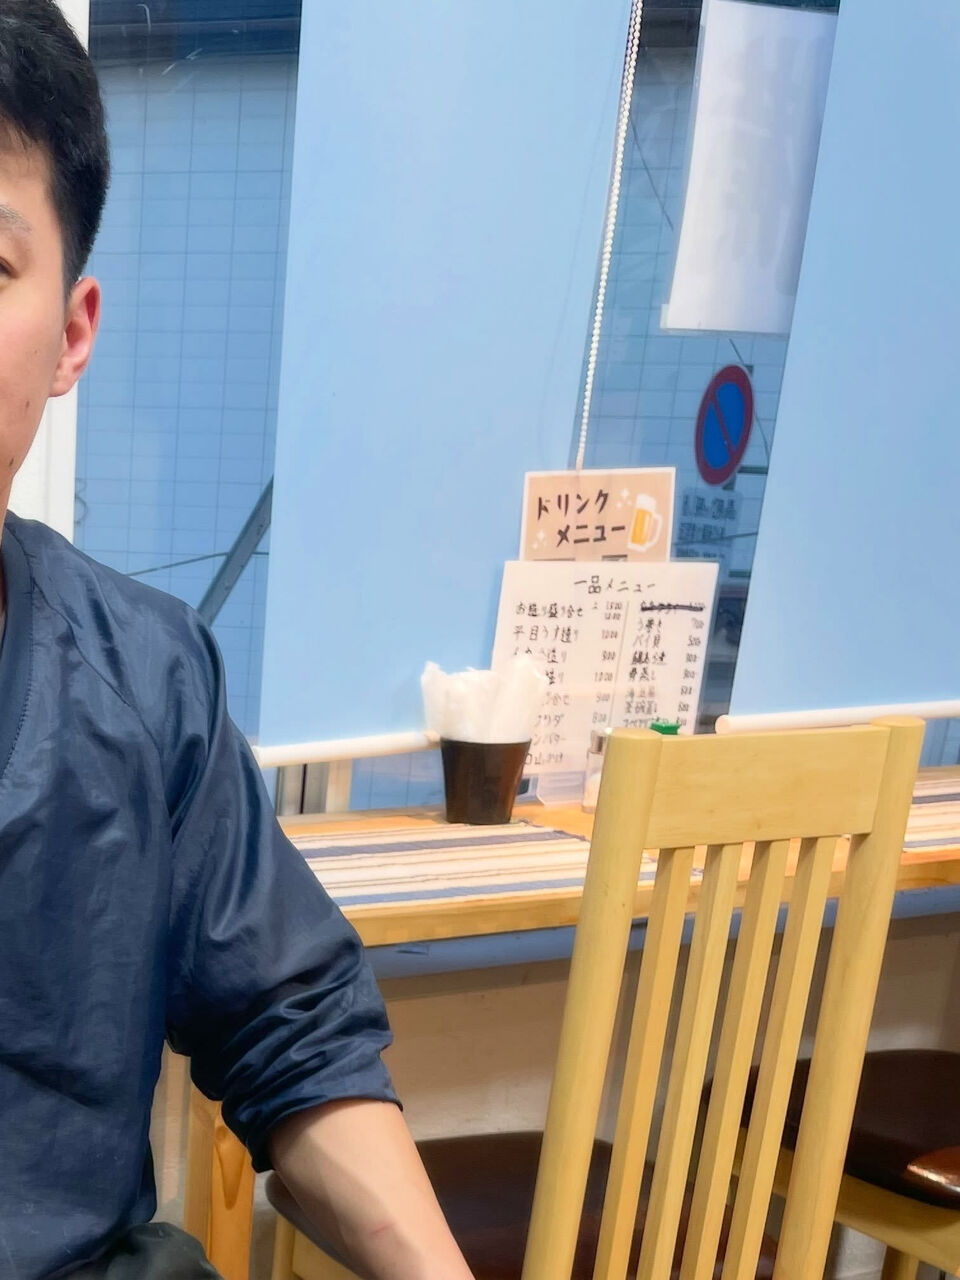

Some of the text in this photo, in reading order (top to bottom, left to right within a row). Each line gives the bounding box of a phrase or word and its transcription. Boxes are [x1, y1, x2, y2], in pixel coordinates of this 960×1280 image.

[537, 489, 610, 521] ドリンク
[555, 524, 627, 548] メニュー
[573, 575, 656, 594] 一品メニュー
